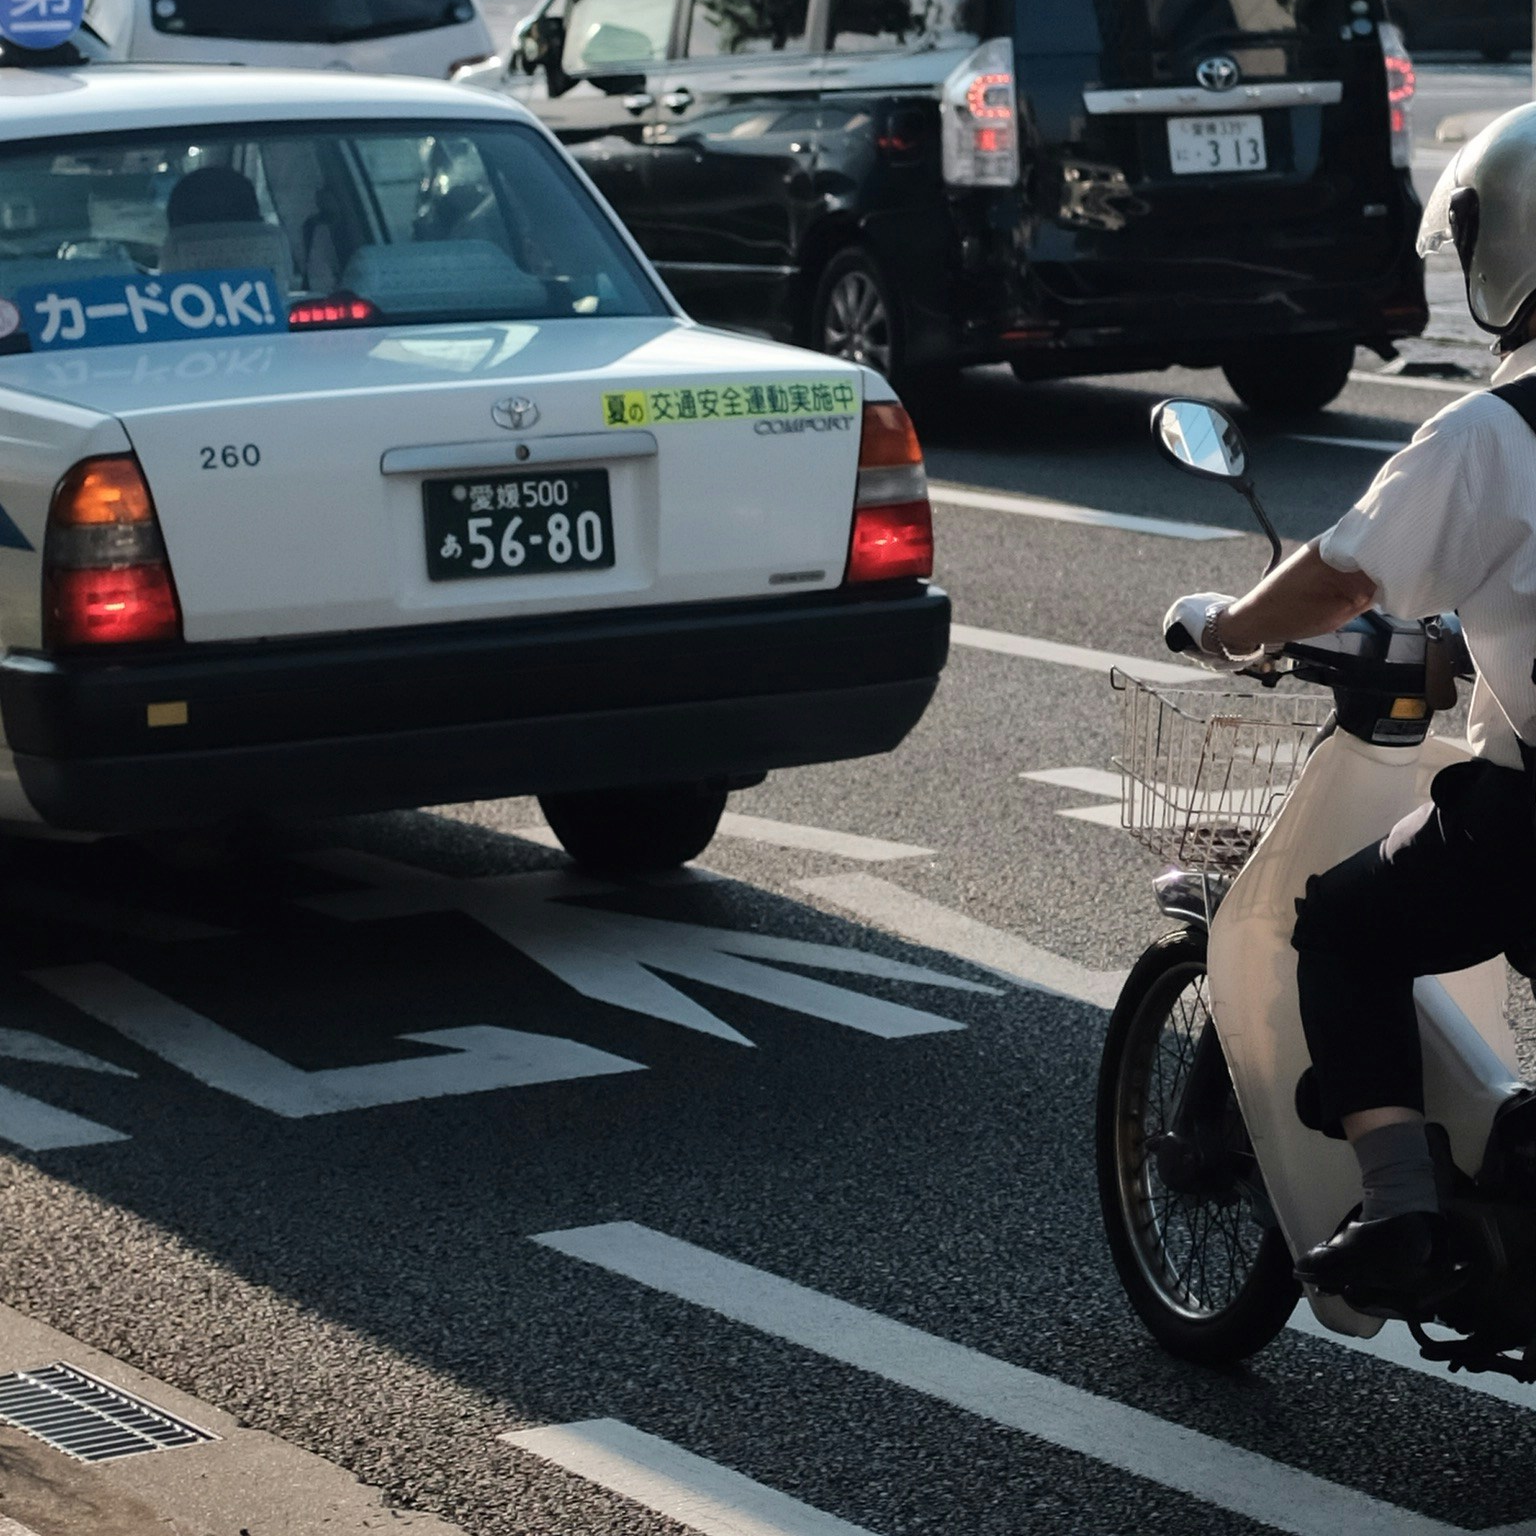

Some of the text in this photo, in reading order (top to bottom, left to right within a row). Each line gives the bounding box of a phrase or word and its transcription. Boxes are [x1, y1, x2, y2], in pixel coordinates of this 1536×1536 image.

[652, 383, 854, 421] 交通安全運動実施中
[200, 443, 261, 470] 260
[467, 510, 604, 570] 56-80
